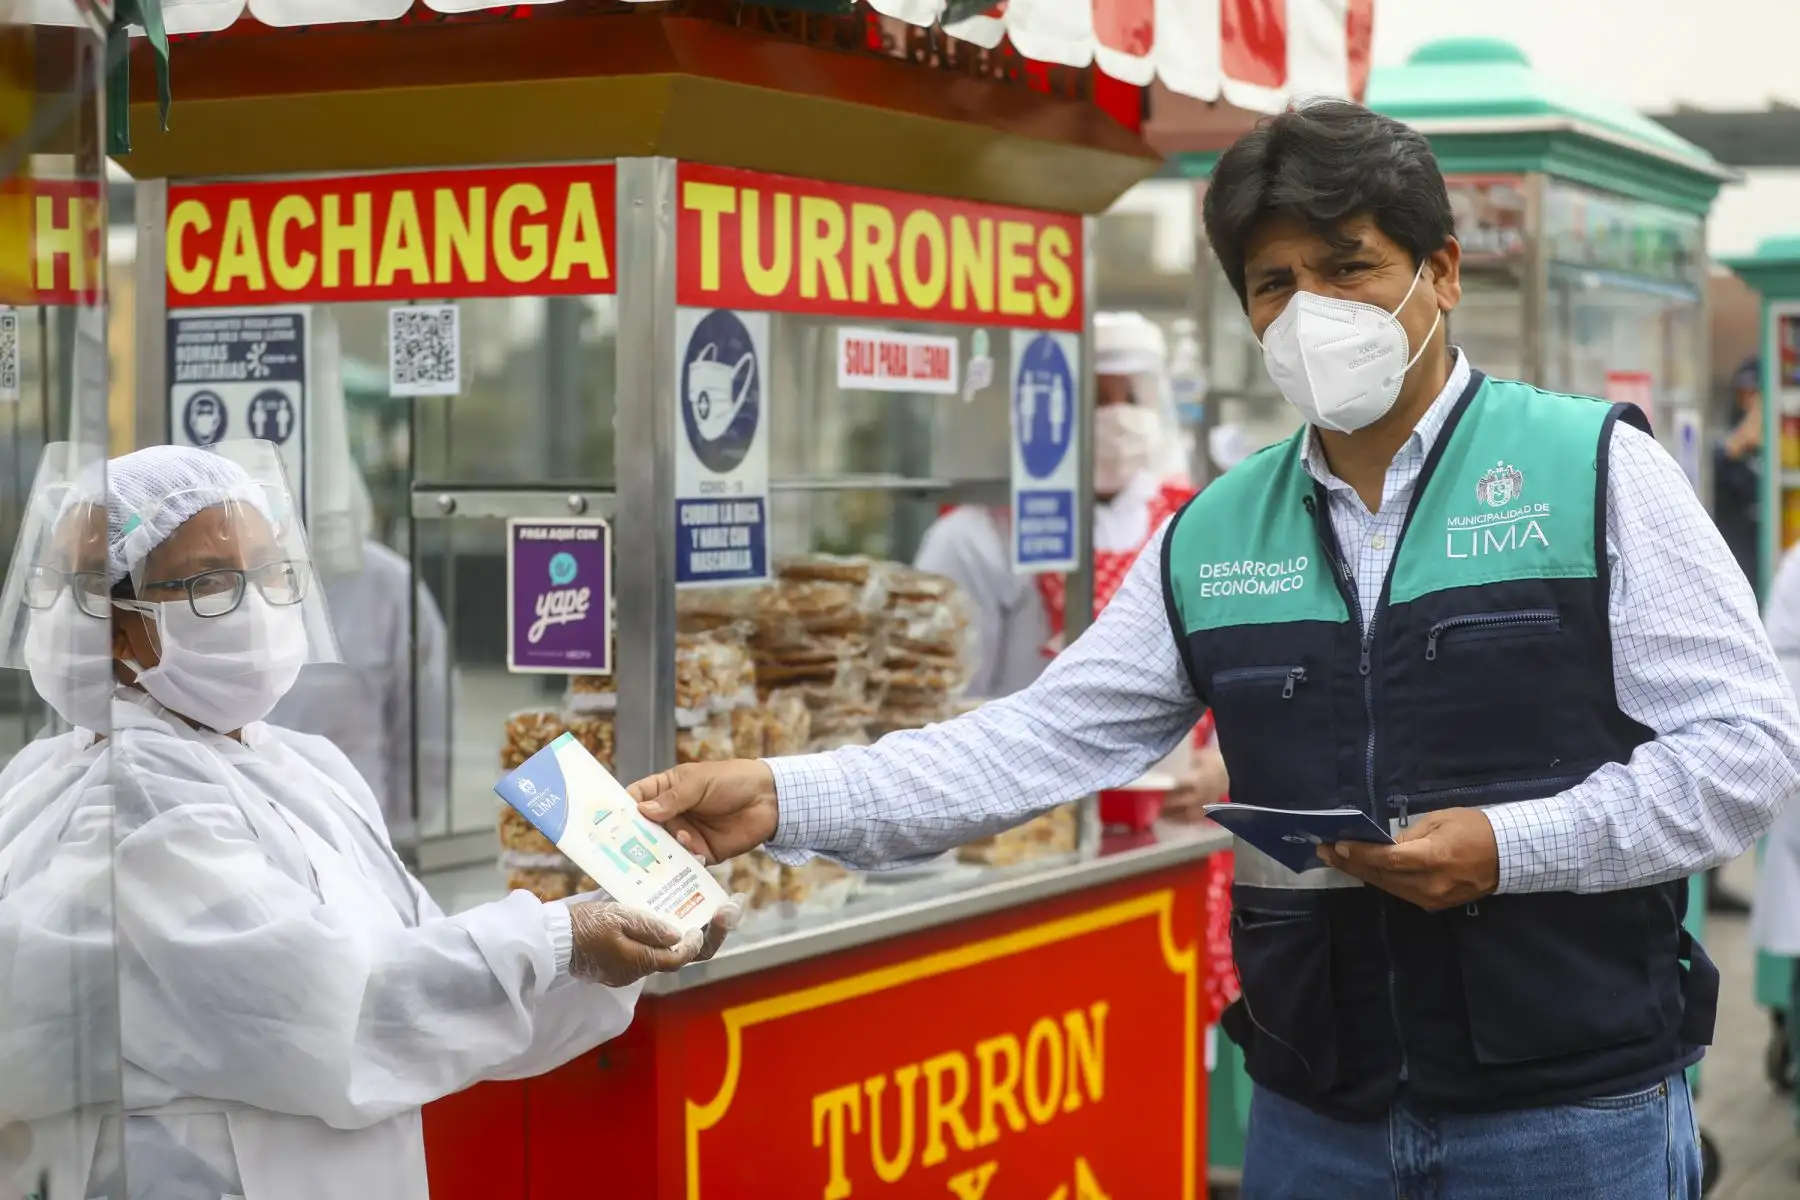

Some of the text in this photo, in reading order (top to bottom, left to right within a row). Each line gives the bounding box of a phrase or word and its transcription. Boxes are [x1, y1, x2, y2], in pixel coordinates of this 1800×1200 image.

[165, 182, 609, 292] CACHANGA
[684, 182, 1073, 318] TURRONES
[1447, 503, 1550, 526] MUNICIPALIDAD DE
[1446, 519, 1550, 558] LIMA
[1199, 556, 1308, 579] DESARROLLO
[1200, 574, 1304, 598] ECONÓMICO
[528, 586, 591, 644] yape
[531, 793, 561, 818] LIMA
[812, 1001, 1108, 1200] TURRON
